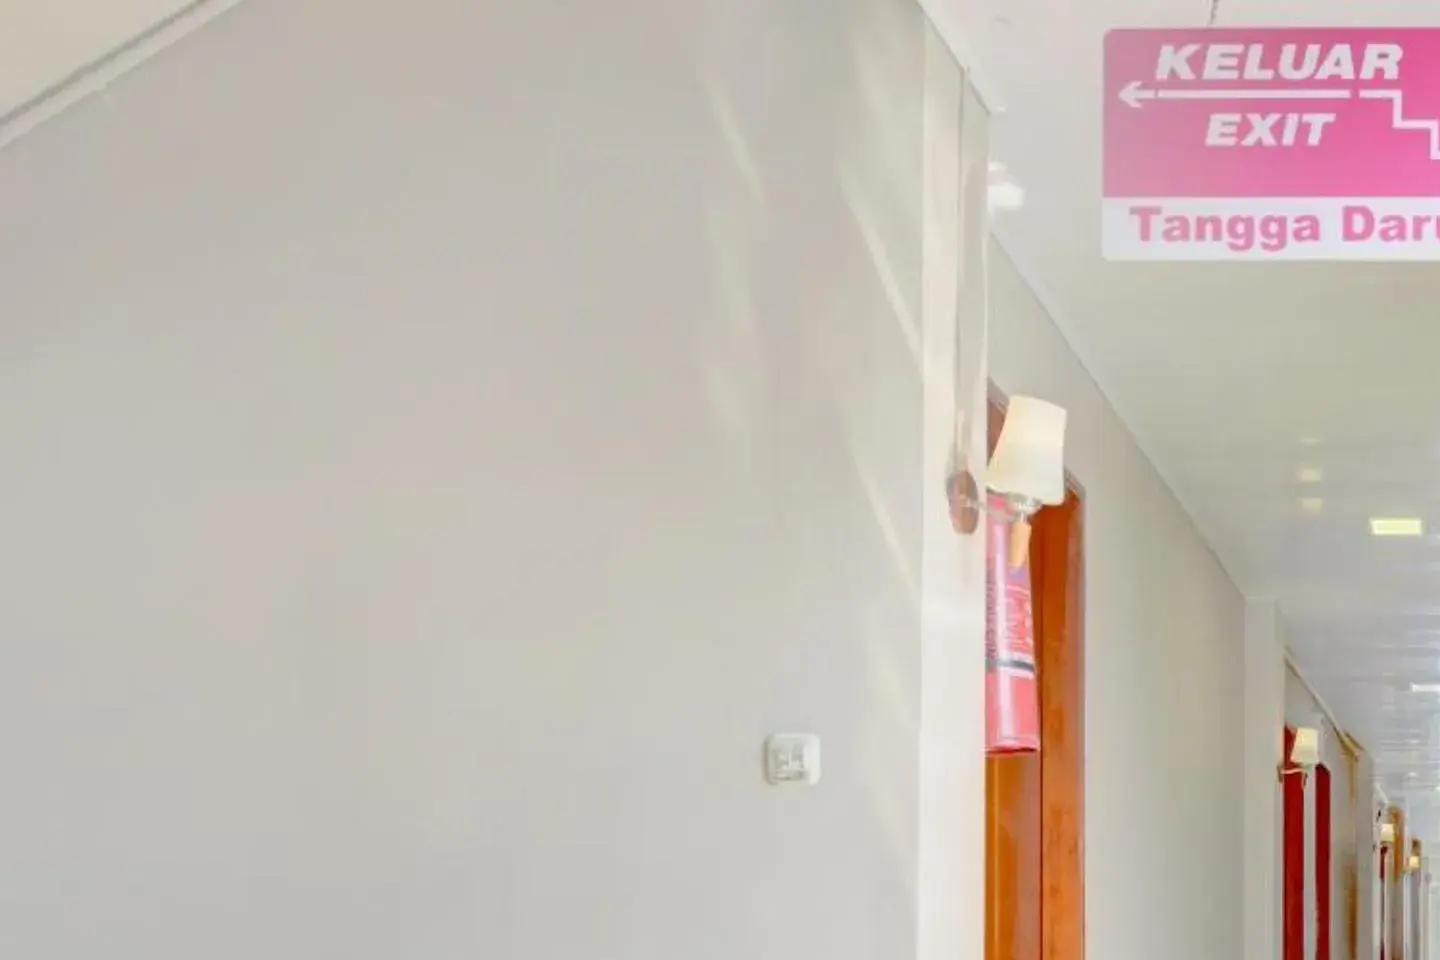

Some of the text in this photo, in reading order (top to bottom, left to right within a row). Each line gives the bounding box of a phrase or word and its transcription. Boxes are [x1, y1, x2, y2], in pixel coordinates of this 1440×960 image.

[1154, 43, 1404, 80] KELUAR
[1204, 112, 1336, 146] EXIT
[1129, 206, 1321, 252] Tangga
